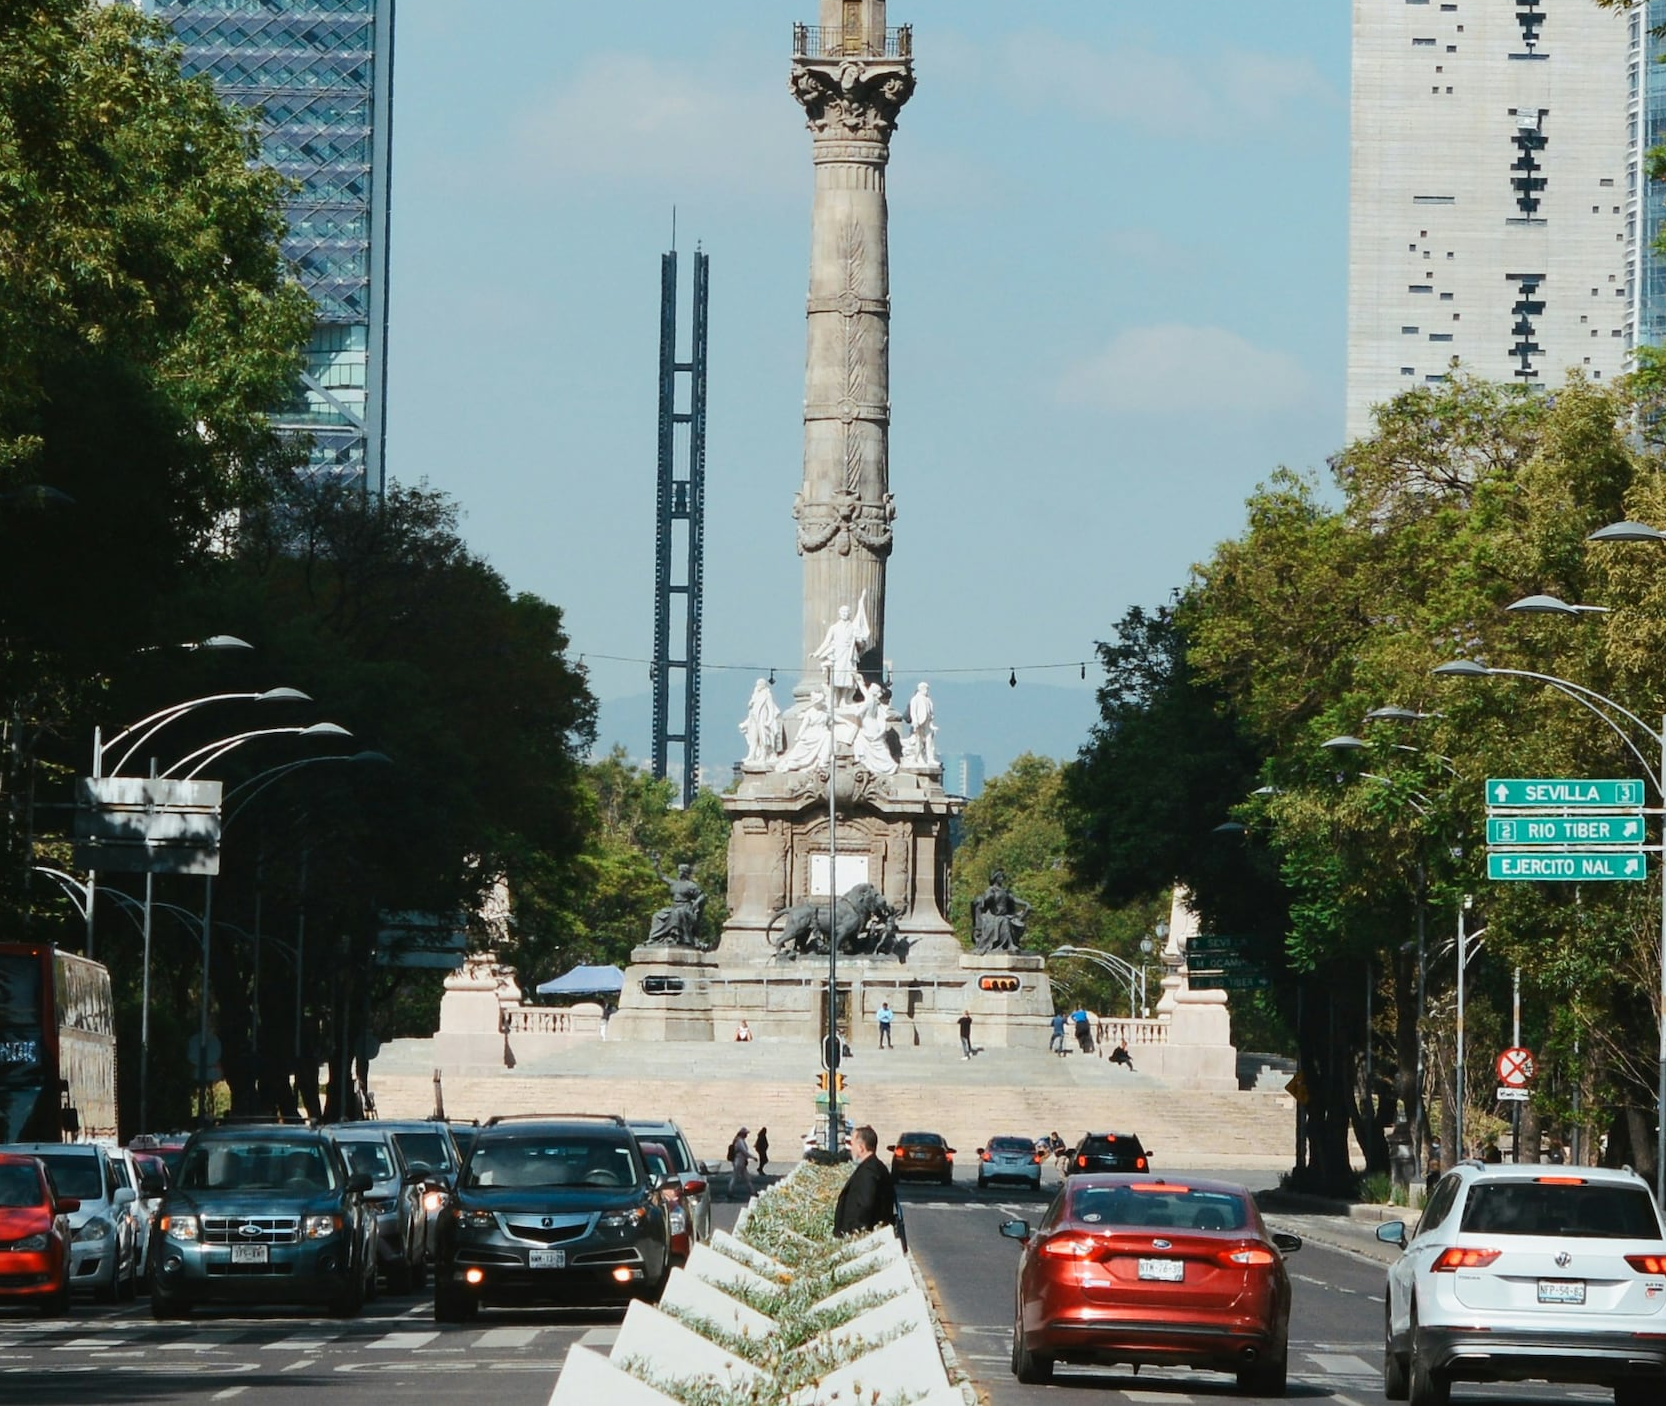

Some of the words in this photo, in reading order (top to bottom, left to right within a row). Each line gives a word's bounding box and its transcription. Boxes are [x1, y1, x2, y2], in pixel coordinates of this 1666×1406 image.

[1525, 785, 1600, 801] SEVILLA
[1621, 786, 1630, 799] 3
[1501, 825, 1510, 836] 2
[1528, 823, 1555, 838] RIO
[1564, 823, 1610, 838] TIBER
[1501, 859, 1574, 875] EJERCITO
[1583, 859, 1614, 875] NAL
